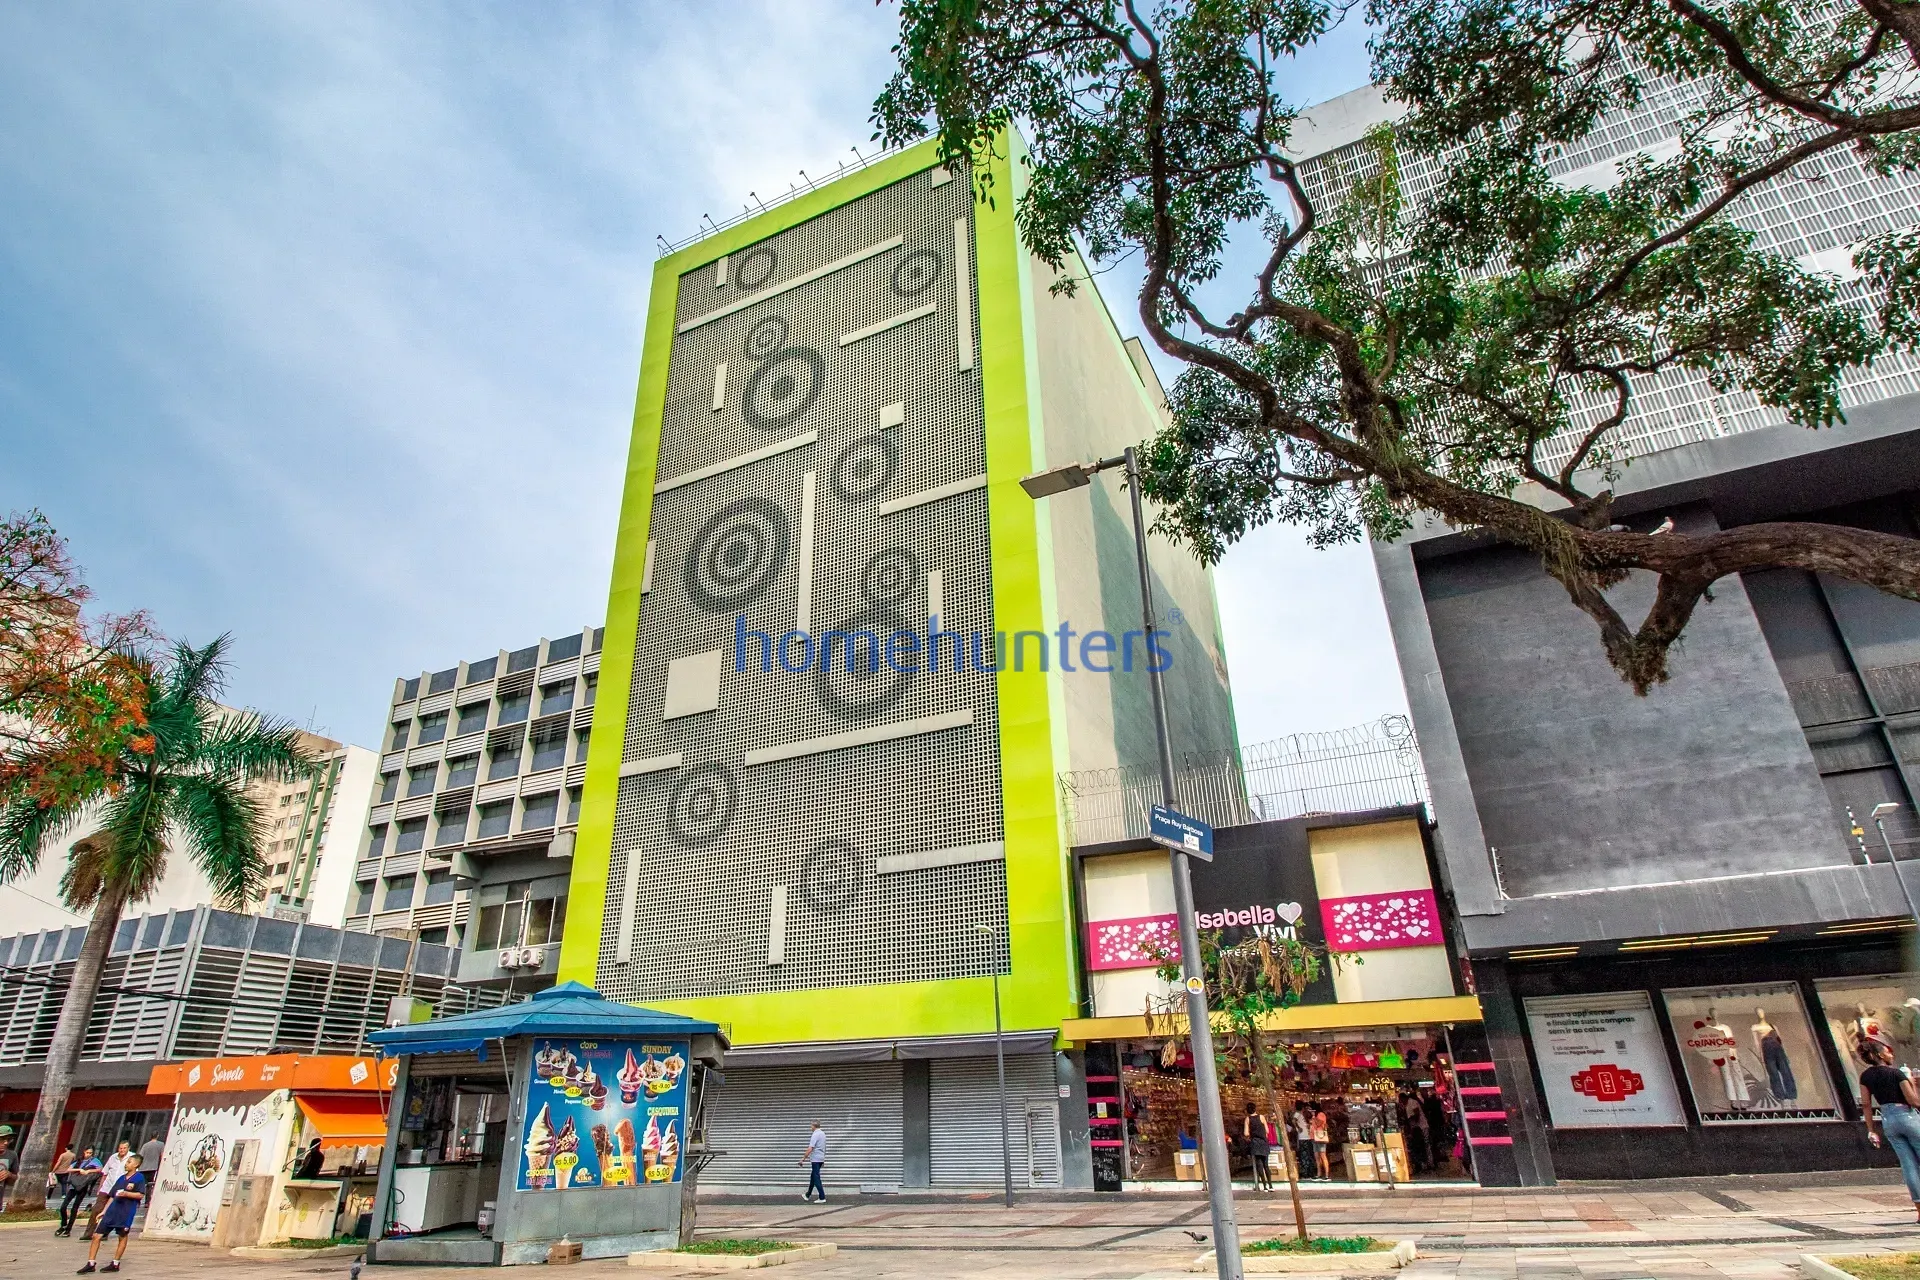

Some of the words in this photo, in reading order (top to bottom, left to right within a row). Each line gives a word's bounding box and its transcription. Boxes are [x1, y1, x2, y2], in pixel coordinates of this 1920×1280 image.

[1154, 813, 1171, 825] Praça
[1171, 819, 1182, 829] Ruy
[1182, 823, 1204, 837] Barbosa
[1194, 905, 1276, 929] Isabella
[1600, 1016, 1635, 1025] compras
[641, 1045, 672, 1054] SUNDAY
[1687, 1037, 1736, 1048] CRIANÇAS
[211, 1063, 245, 1086] Sorvete
[177, 1118, 208, 1135] Sorvetes
